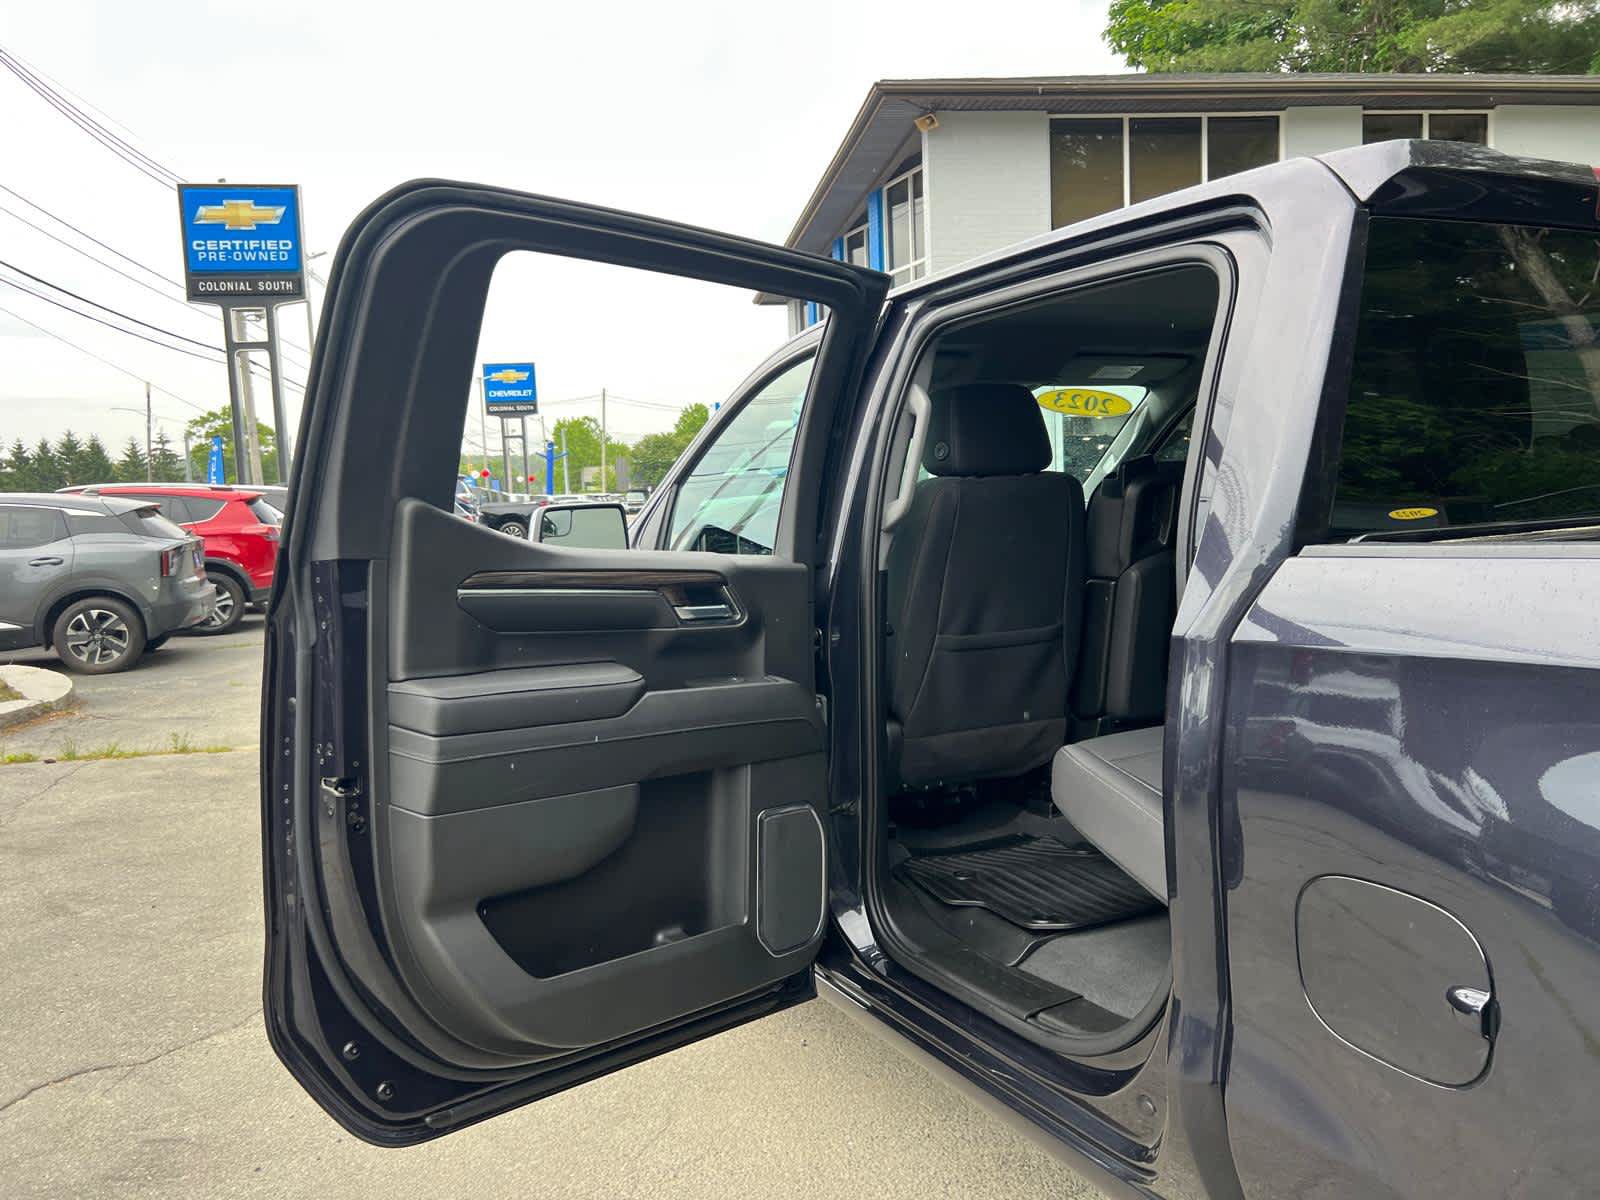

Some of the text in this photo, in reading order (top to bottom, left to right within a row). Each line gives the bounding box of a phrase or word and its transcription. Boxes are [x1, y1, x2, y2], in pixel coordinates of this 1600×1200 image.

[192, 239, 293, 251] CERTIFIED
[197, 250, 289, 262] PRE-OWNED
[198, 280, 293, 292] COLONIAL SOUTH
[488, 389, 533, 398] CHEVROLET
